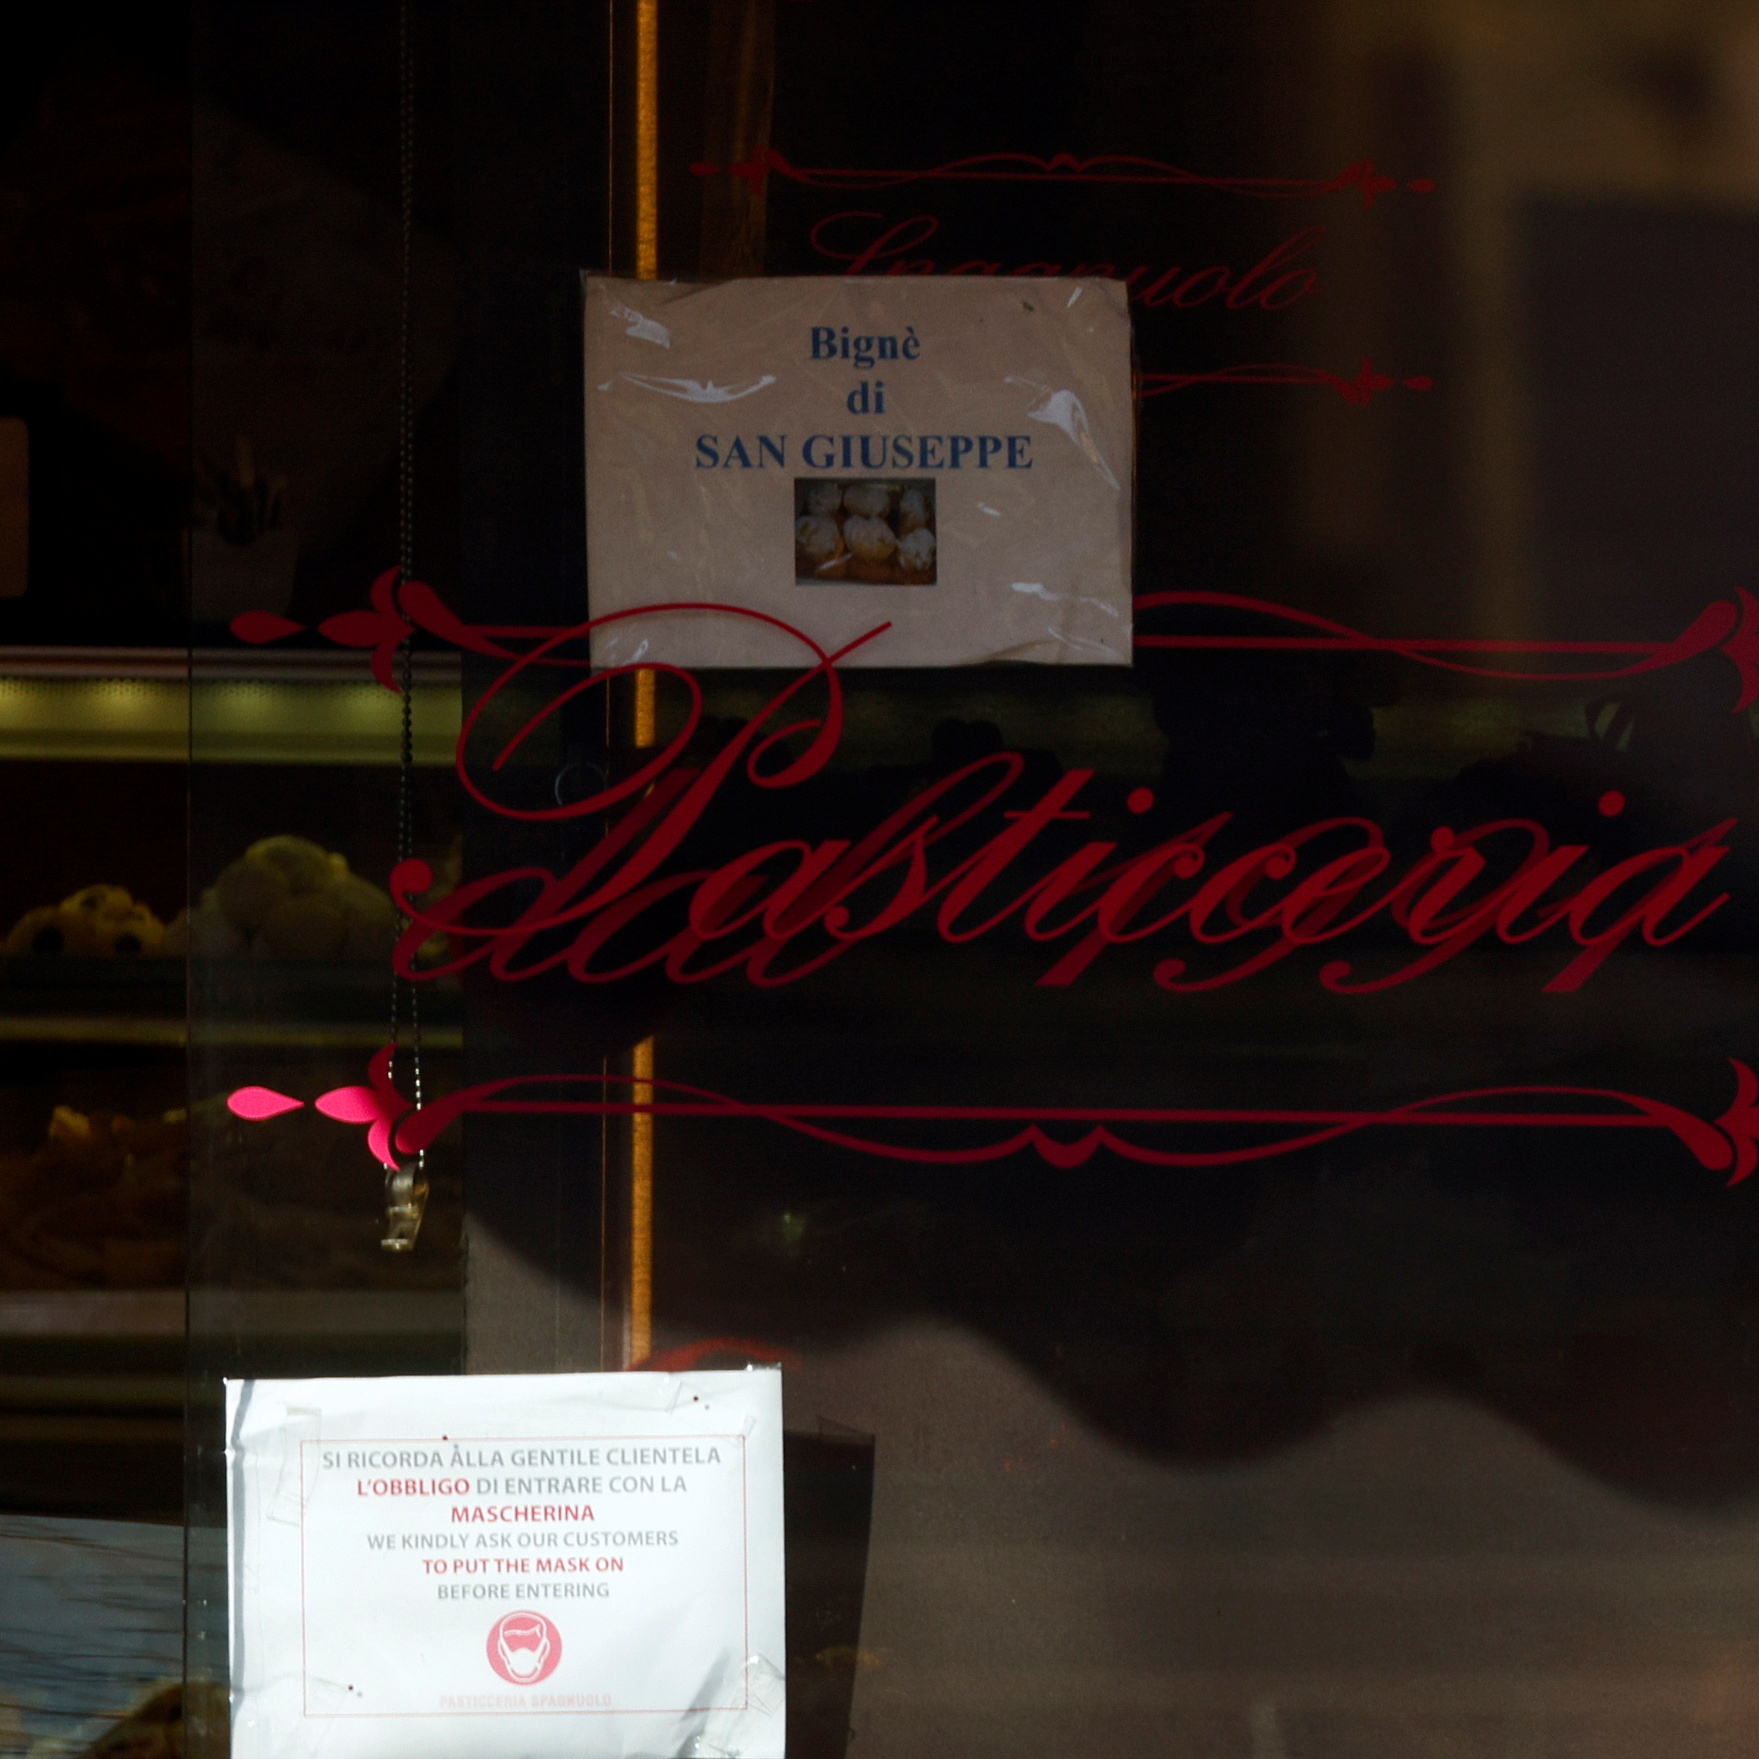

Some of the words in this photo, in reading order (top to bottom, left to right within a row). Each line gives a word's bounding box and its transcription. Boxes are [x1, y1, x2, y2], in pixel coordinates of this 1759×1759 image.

[810, 326, 921, 367] Bignè
[847, 381, 886, 415] di
[696, 434, 788, 469] SAN
[802, 434, 1033, 469] GIUSEPPE
[390, 603, 1732, 946] Pasticceria
[323, 1452, 346, 1469] SI
[348, 1451, 443, 1467] RICORDA
[452, 1449, 505, 1467] ALLA
[511, 1449, 599, 1466] GENTILE
[607, 1447, 720, 1465] CLIENTELA
[358, 1479, 469, 1495] L'OBBLIGO
[477, 1478, 498, 1494] DI
[505, 1477, 601, 1494] ENTRARE
[609, 1476, 654, 1492] CON
[661, 1476, 686, 1492] LA
[452, 1505, 594, 1522] MASCHERINA
[368, 1535, 395, 1549] WE
[402, 1534, 468, 1548] KINDLY
[476, 1533, 511, 1547] ASK
[517, 1533, 557, 1547] OUR
[564, 1531, 678, 1546] CUSTOMERS
[424, 1560, 447, 1573] TO
[454, 1559, 491, 1573] PUT
[495, 1559, 531, 1572] THE
[537, 1558, 589, 1572] MASK
[596, 1558, 623, 1571] ON
[438, 1584, 509, 1599] BEFORE
[516, 1583, 609, 1598] ENTERING
[439, 1695, 526, 1707] PASTICCERIA
[531, 1693, 613, 1706] SPAGNUOLO
